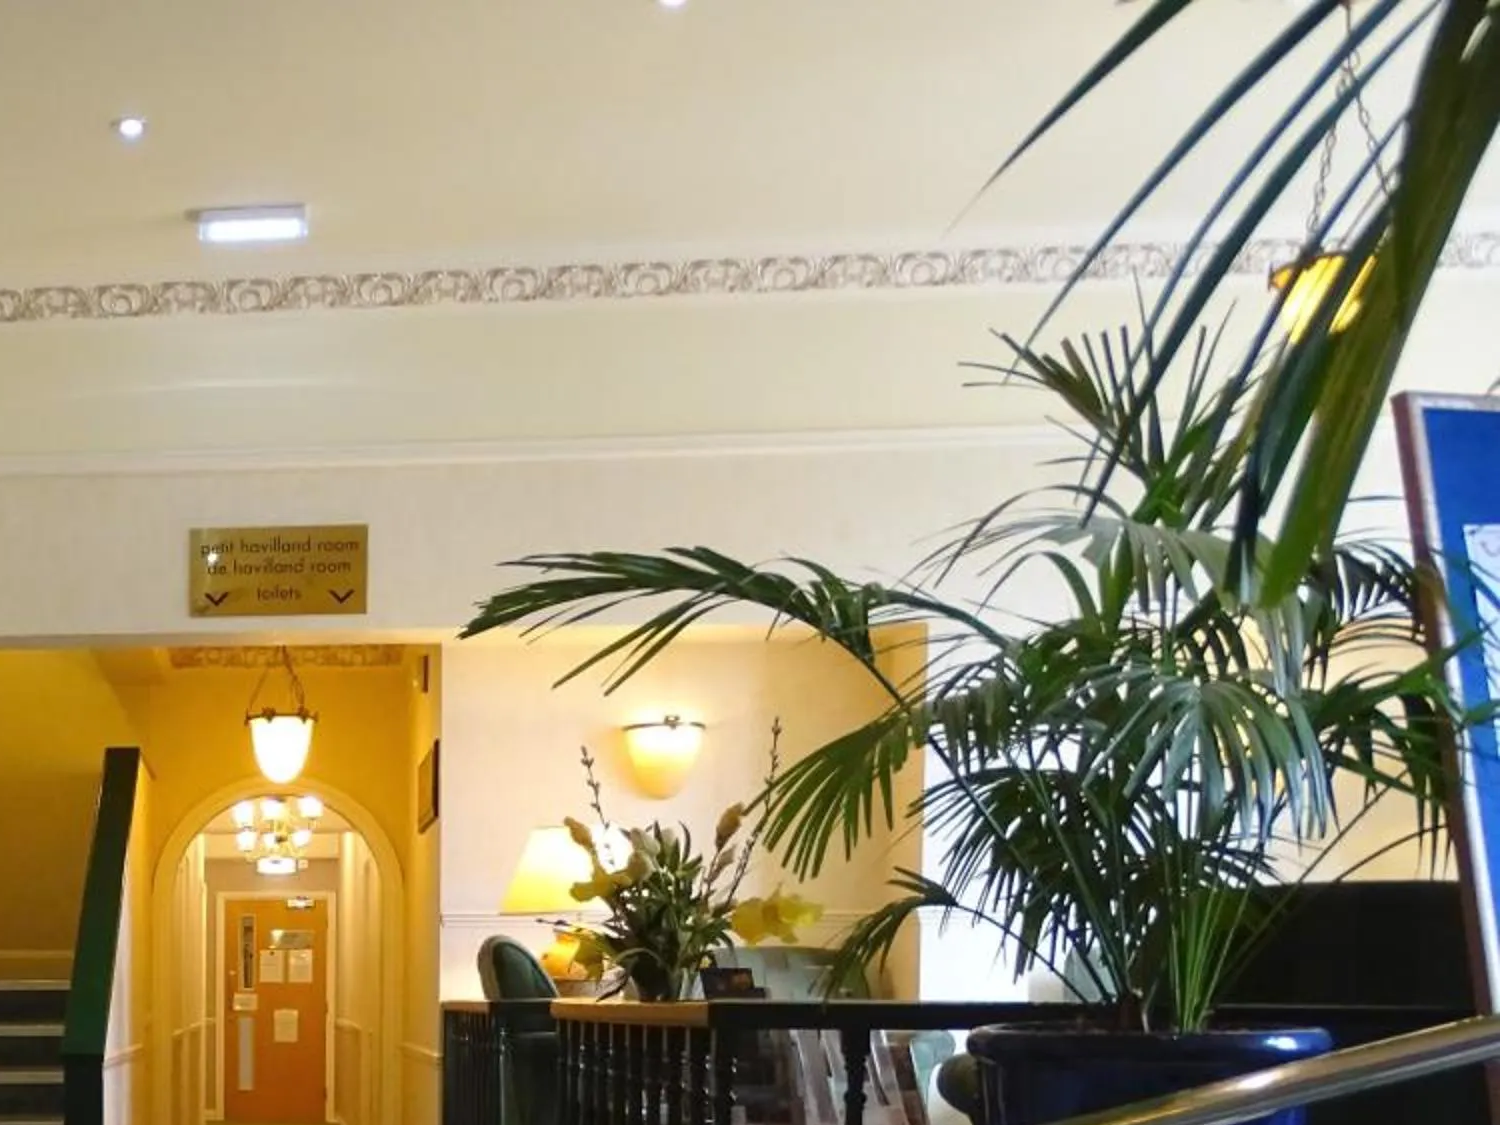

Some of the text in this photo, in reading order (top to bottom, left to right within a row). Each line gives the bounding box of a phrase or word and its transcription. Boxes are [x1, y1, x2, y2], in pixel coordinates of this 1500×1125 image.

[240, 536, 311, 553] havilland
[317, 540, 360, 552] room
[311, 560, 351, 574] room
[257, 585, 303, 601] toilets
